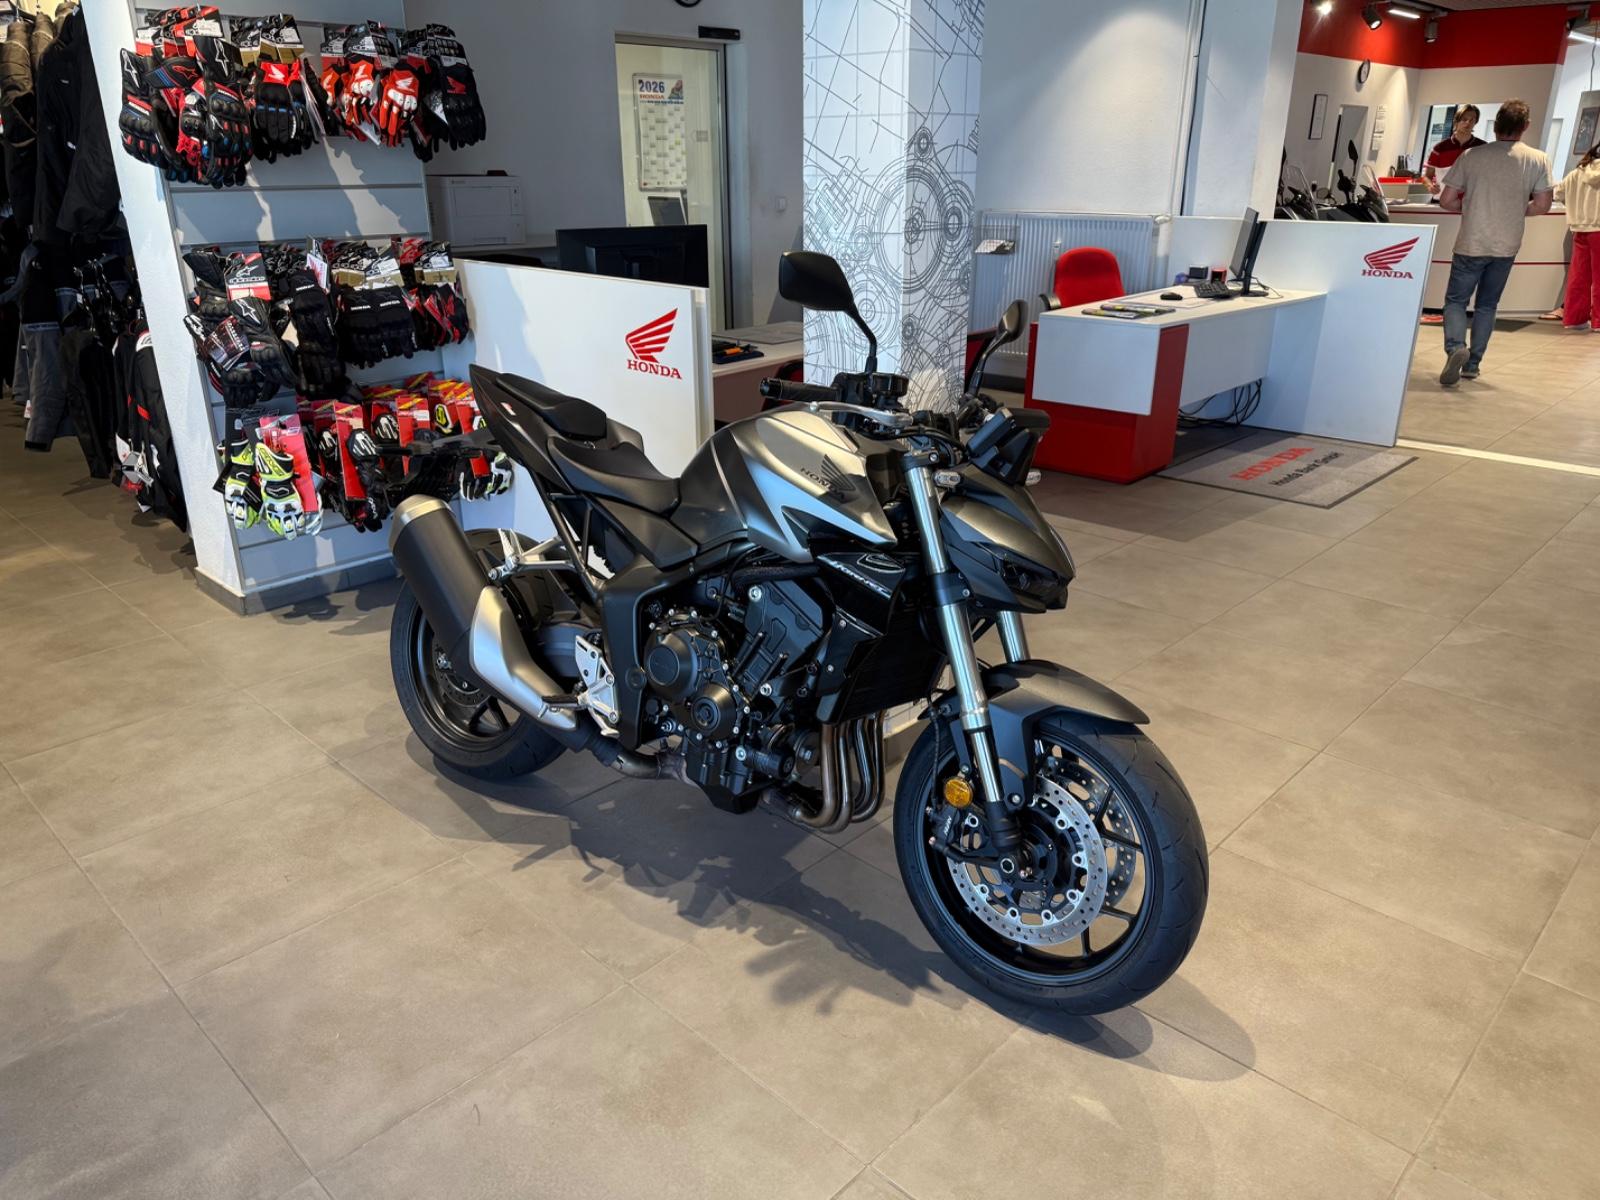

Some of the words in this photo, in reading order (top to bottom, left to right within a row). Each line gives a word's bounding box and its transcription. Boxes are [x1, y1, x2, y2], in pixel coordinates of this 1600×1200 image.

[639, 81, 665, 93] 2026
[1362, 269, 1413, 279] HONDA
[627, 359, 682, 380] HONDA
[1230, 447, 1313, 480] HONDA
[800, 467, 847, 502] HONDA
